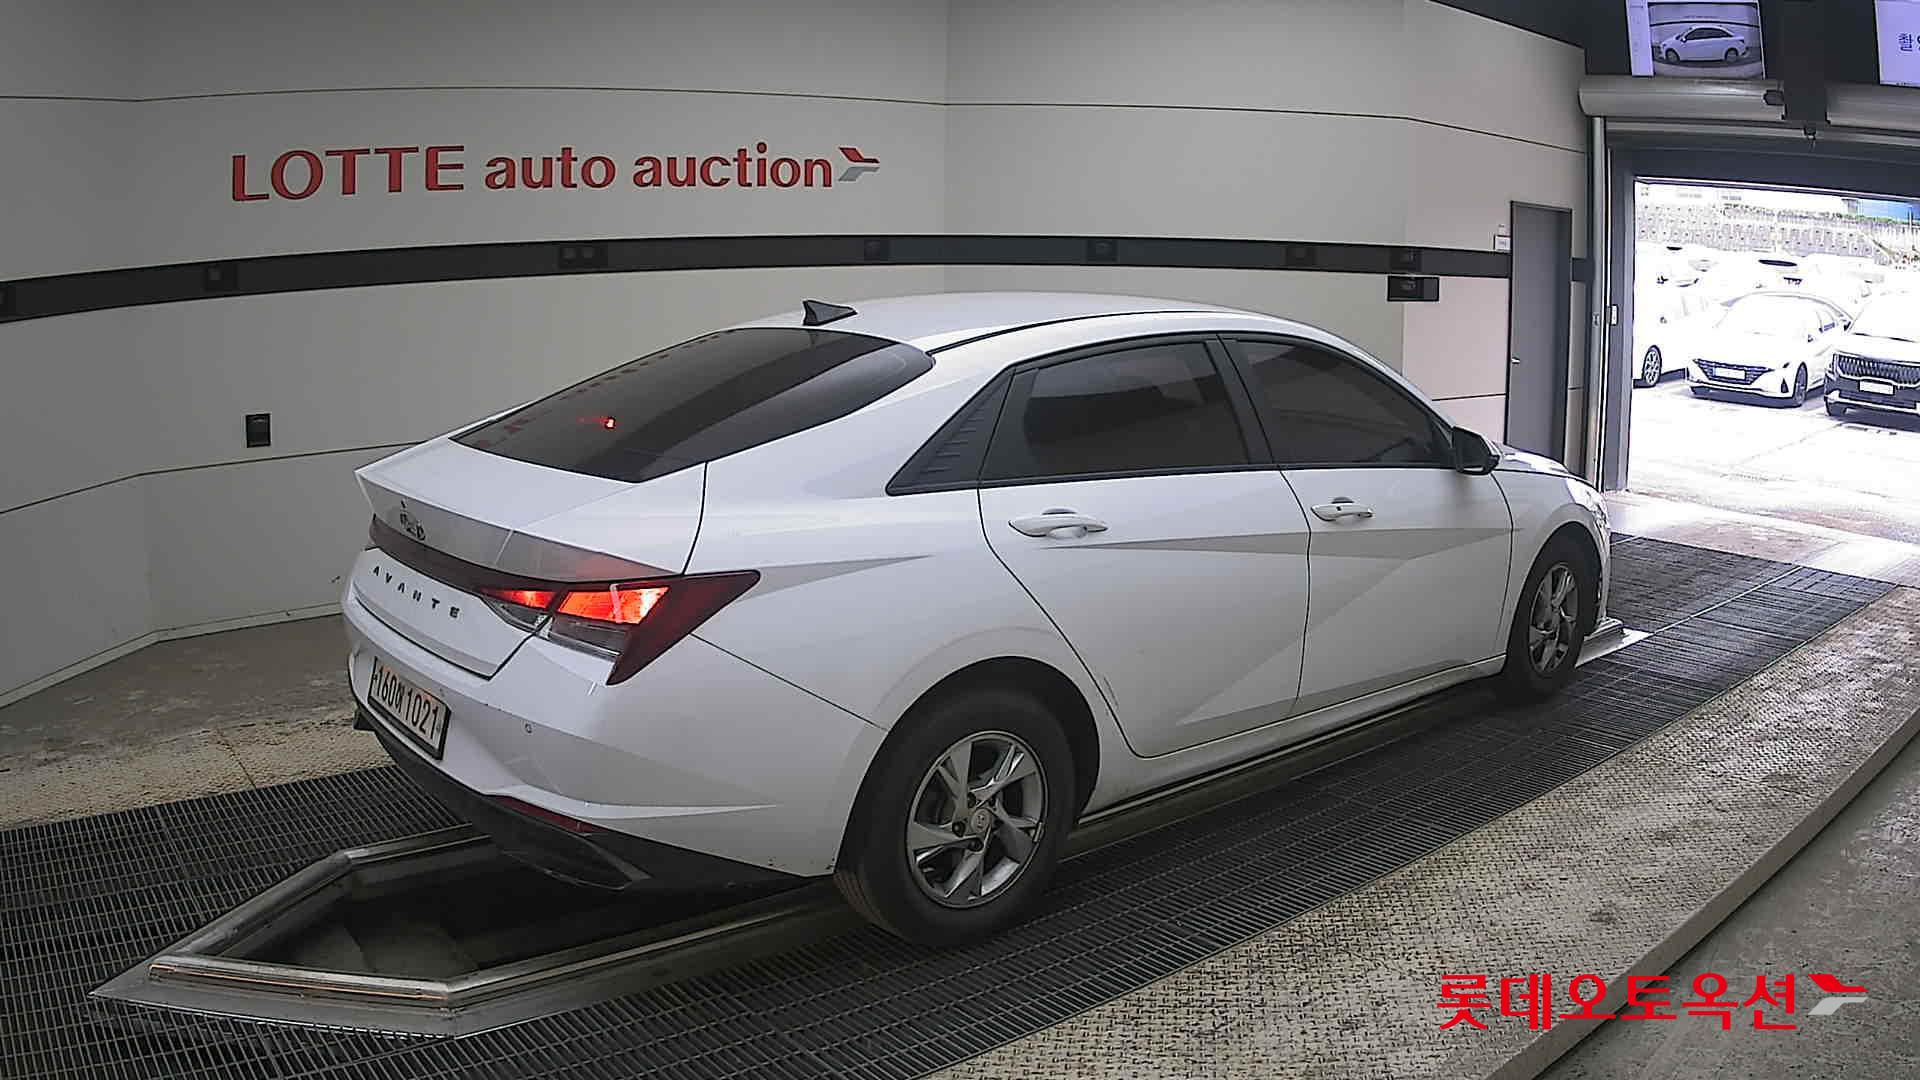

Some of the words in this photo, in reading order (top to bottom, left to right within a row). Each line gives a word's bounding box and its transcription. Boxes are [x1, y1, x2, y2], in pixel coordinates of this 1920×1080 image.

[232, 145, 465, 202] LOTTE
[485, 146, 617, 189] auto
[633, 141, 833, 188] auction
[372, 565, 460, 619] AVANTE
